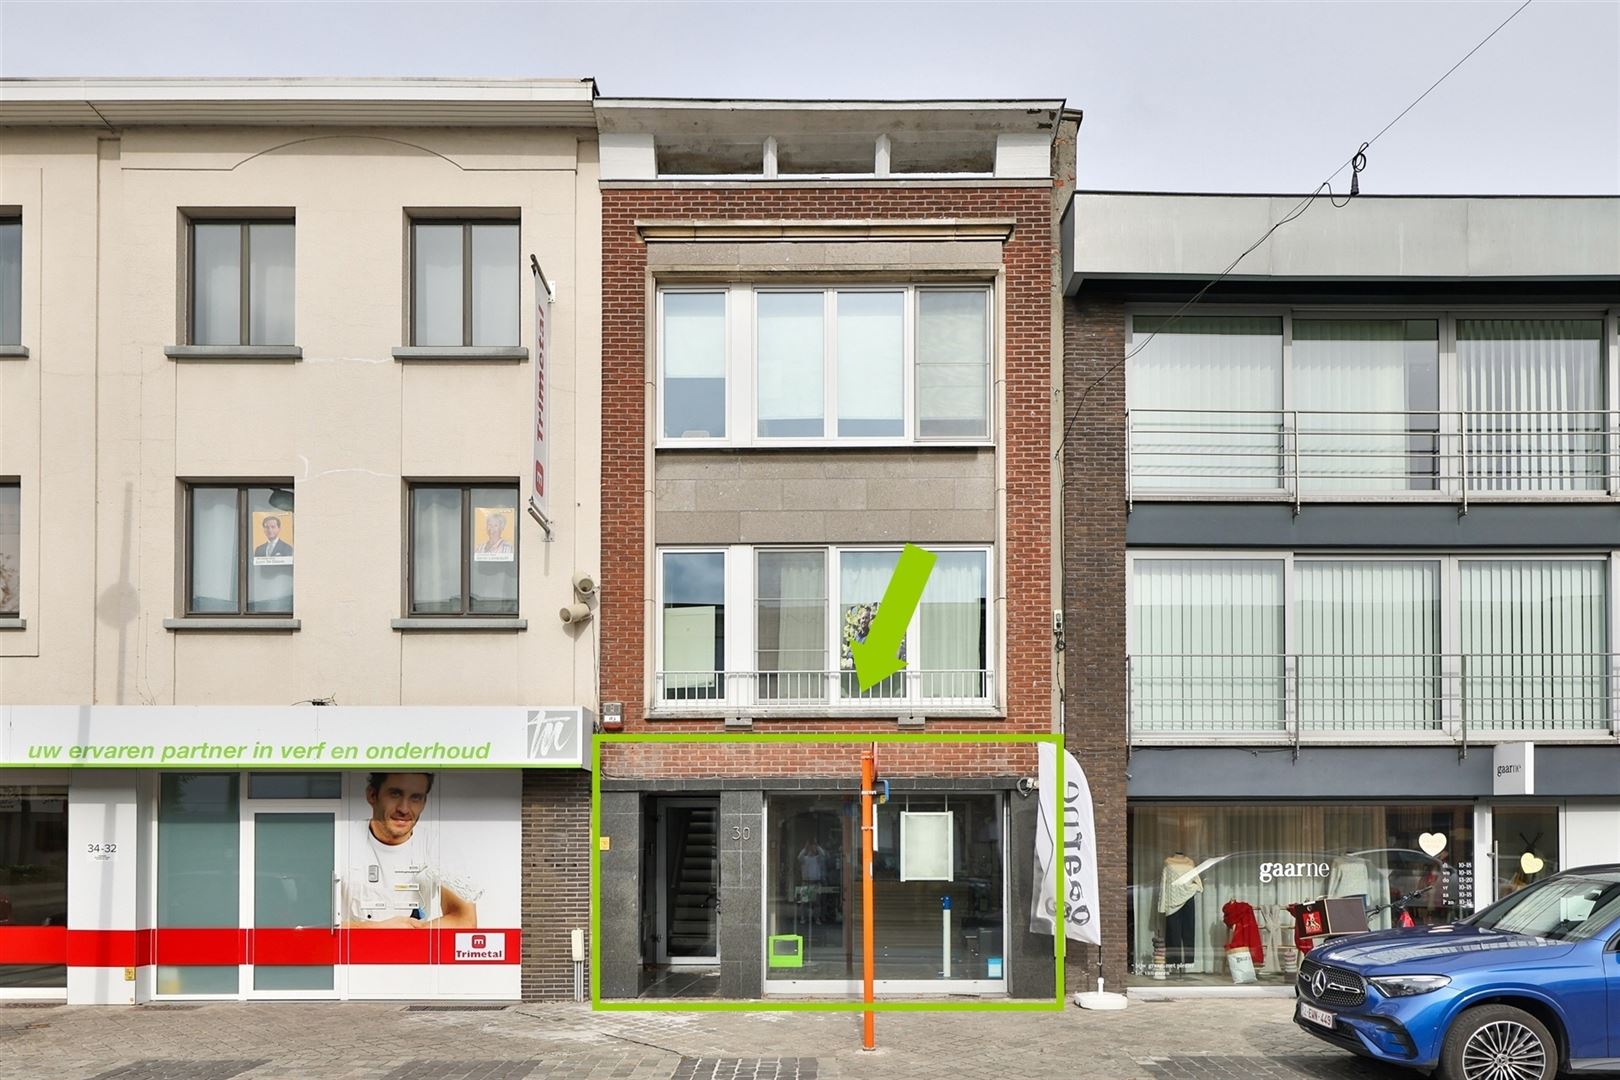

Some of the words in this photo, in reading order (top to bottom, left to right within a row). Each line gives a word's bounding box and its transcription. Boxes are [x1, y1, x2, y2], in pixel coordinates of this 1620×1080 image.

[536, 304, 545, 442] Trimetal
[28, 744, 63, 759] uw
[69, 744, 154, 759] ervaren
[160, 742, 247, 762] partner
[252, 741, 272, 759] in
[281, 741, 327, 759] verf
[331, 744, 359, 759] en
[366, 742, 491, 759] onderhoud
[1496, 764, 1521, 777] gaarne
[732, 826, 750, 840] 30
[87, 843, 117, 853] 34-32
[1259, 862, 1330, 883] gaarne
[456, 950, 502, 958] Trimetal
